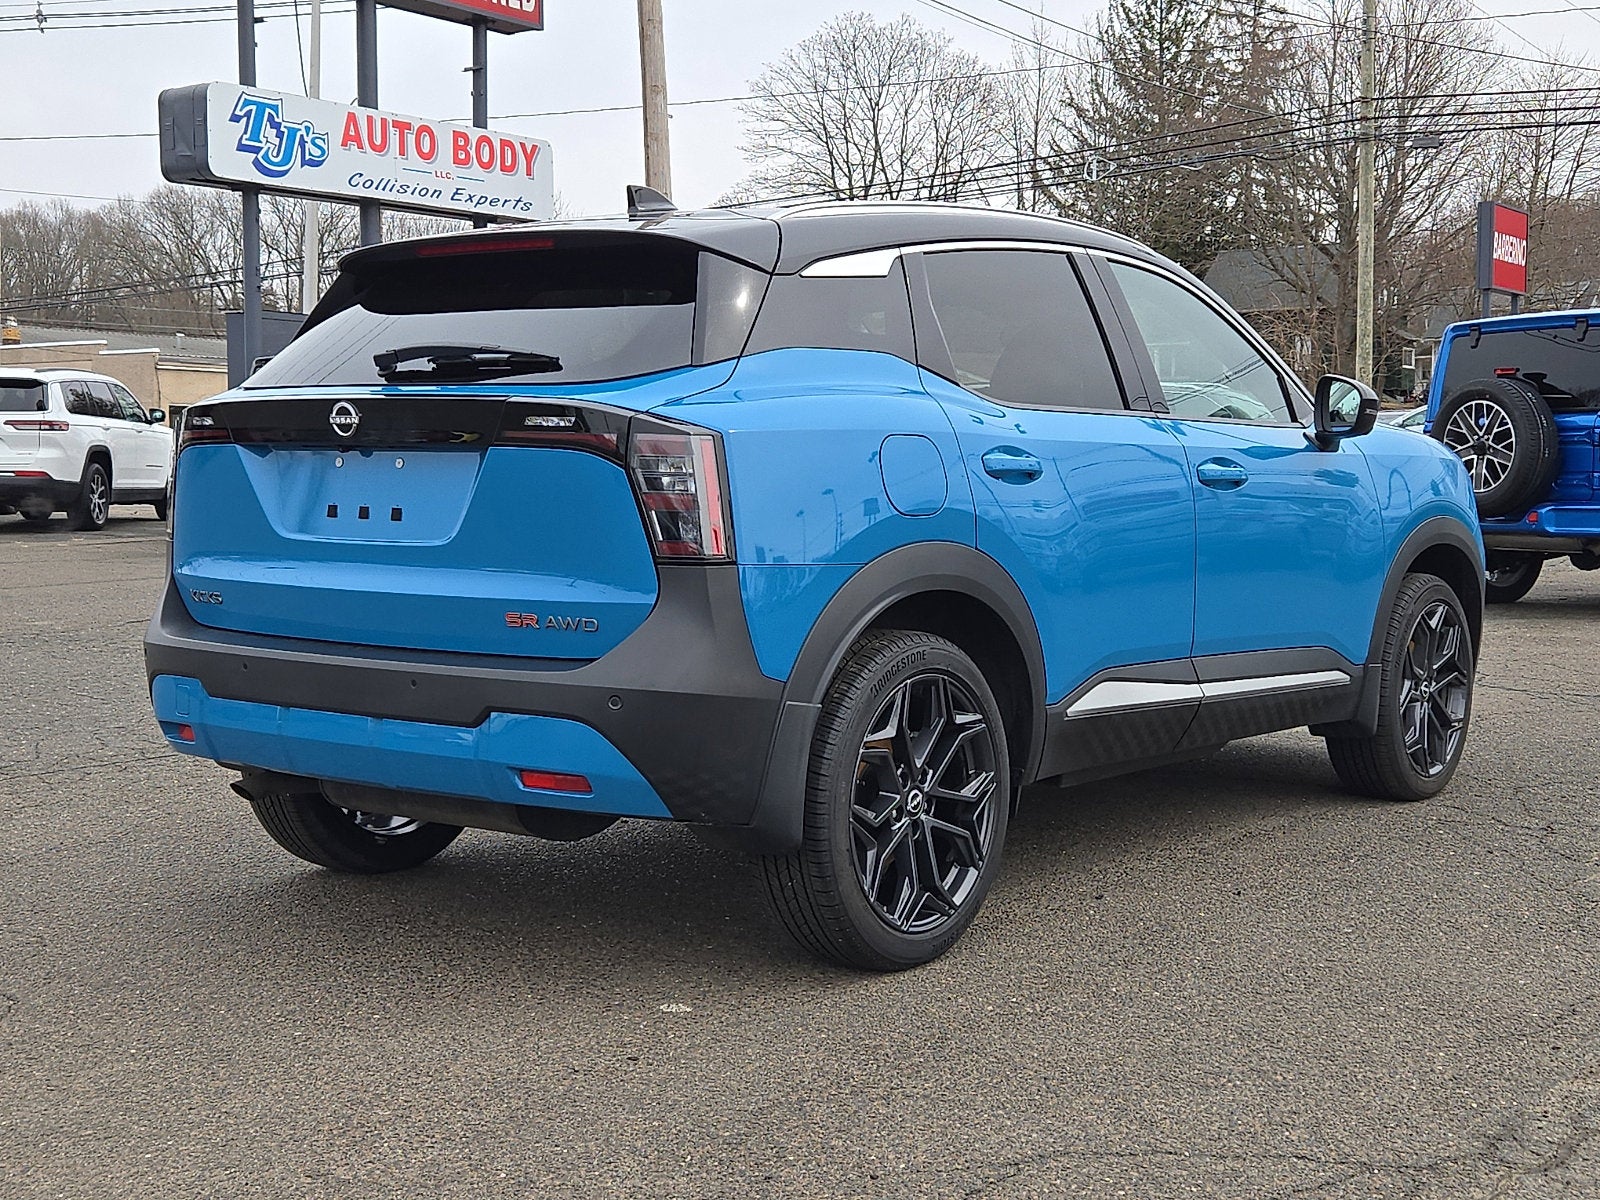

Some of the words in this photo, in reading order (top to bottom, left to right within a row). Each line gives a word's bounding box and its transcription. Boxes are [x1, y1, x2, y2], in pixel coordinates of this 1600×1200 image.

[229, 92, 329, 177] TJ's
[340, 111, 437, 161] AUTO
[452, 130, 538, 177] BODY
[348, 172, 443, 199] Collision
[450, 187, 534, 212] Experts
[505, 611, 539, 629] SR
[545, 615, 599, 632] AWD
[870, 649, 927, 699] BRIDGESTONE
